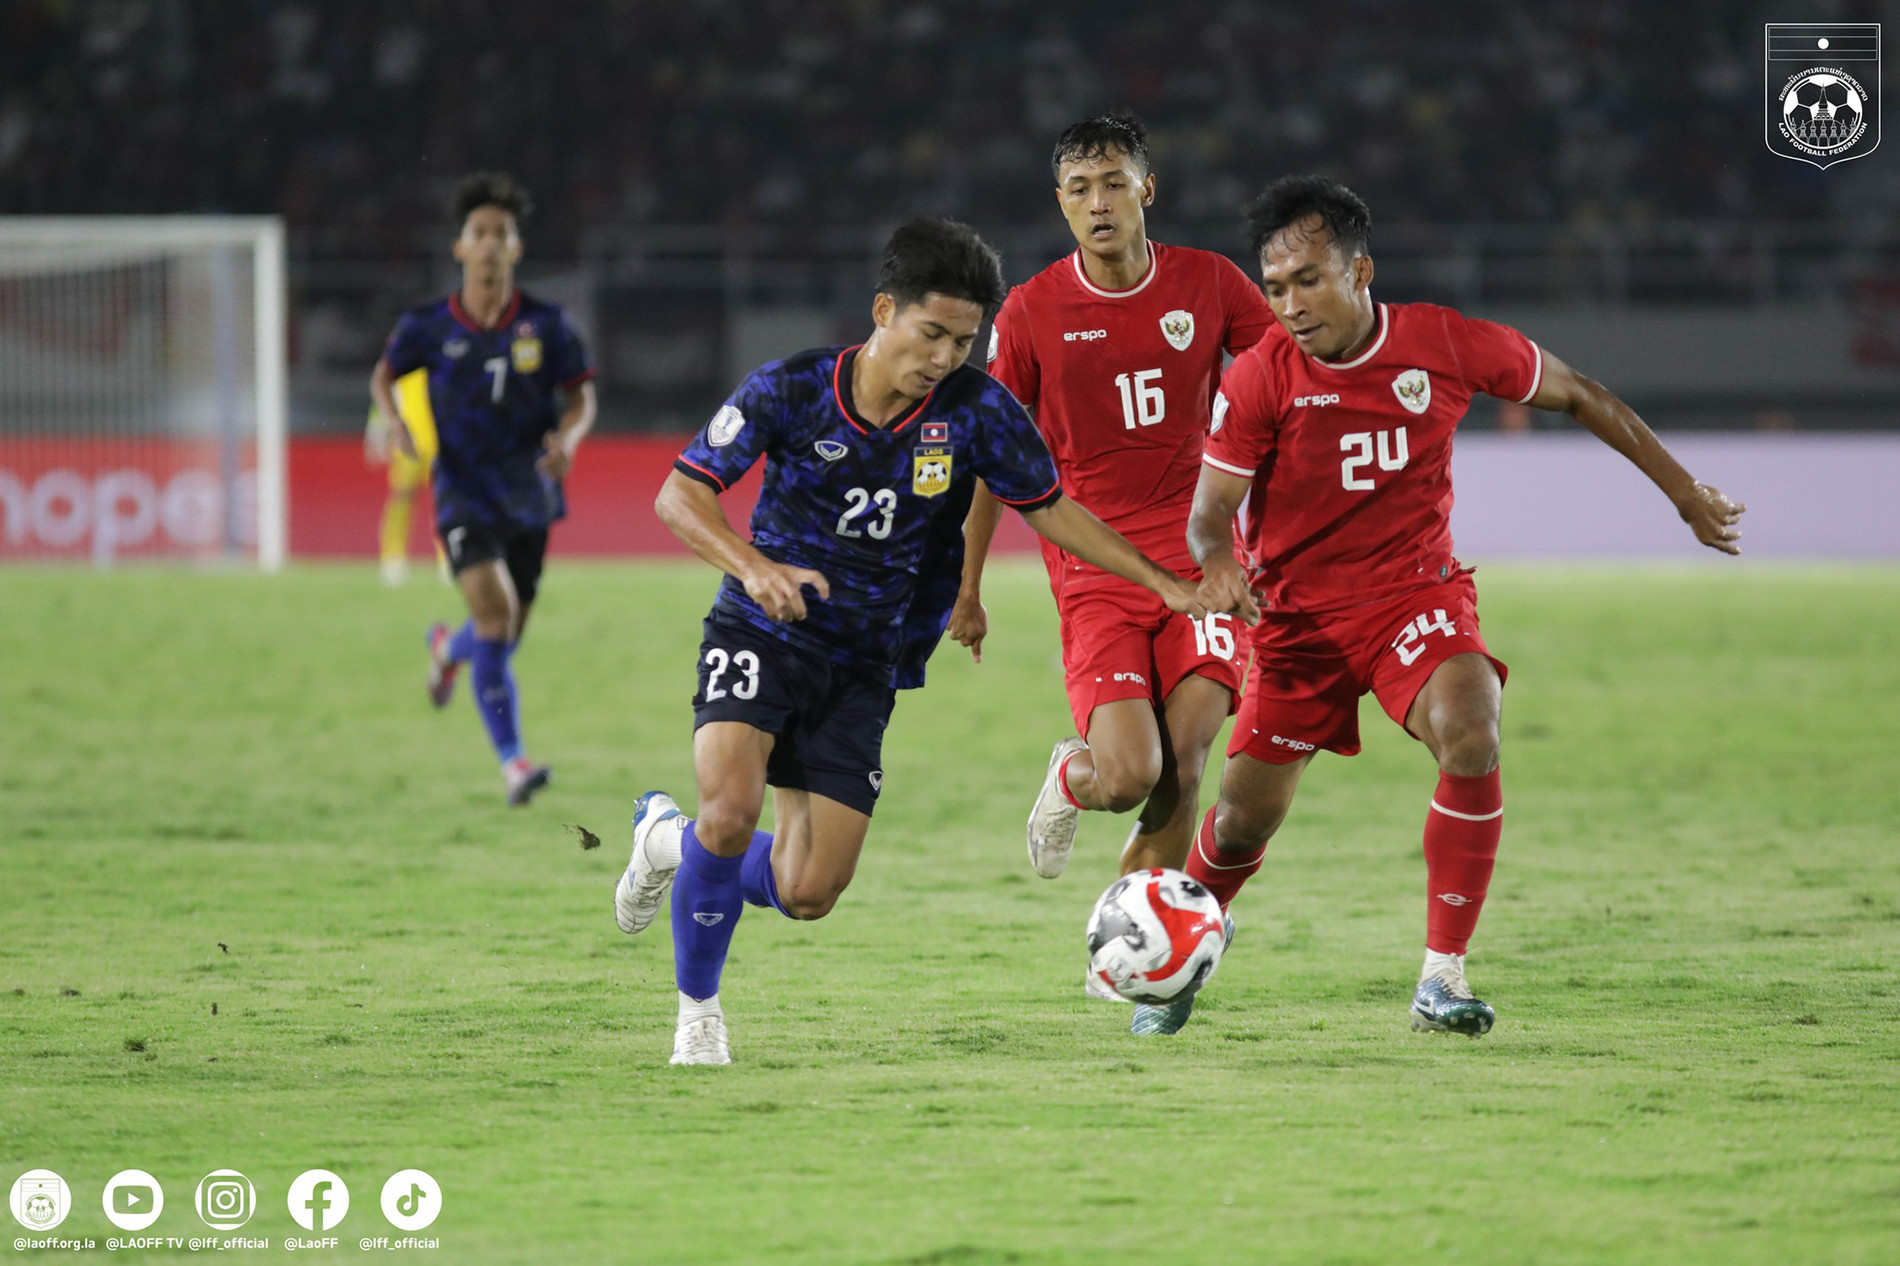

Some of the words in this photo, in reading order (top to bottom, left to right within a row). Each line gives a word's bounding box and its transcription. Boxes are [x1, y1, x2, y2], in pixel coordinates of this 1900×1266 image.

[1063, 328, 1107, 342] erspo
[484, 356, 507, 402] 7
[1114, 367, 1165, 430] 16
[1294, 393, 1340, 407] erspo
[835, 487, 898, 540] 23
[1187, 610, 1235, 661] 16
[1391, 609, 1457, 667] 24
[705, 647, 760, 703] 23
[1271, 735, 1315, 751] erspo
